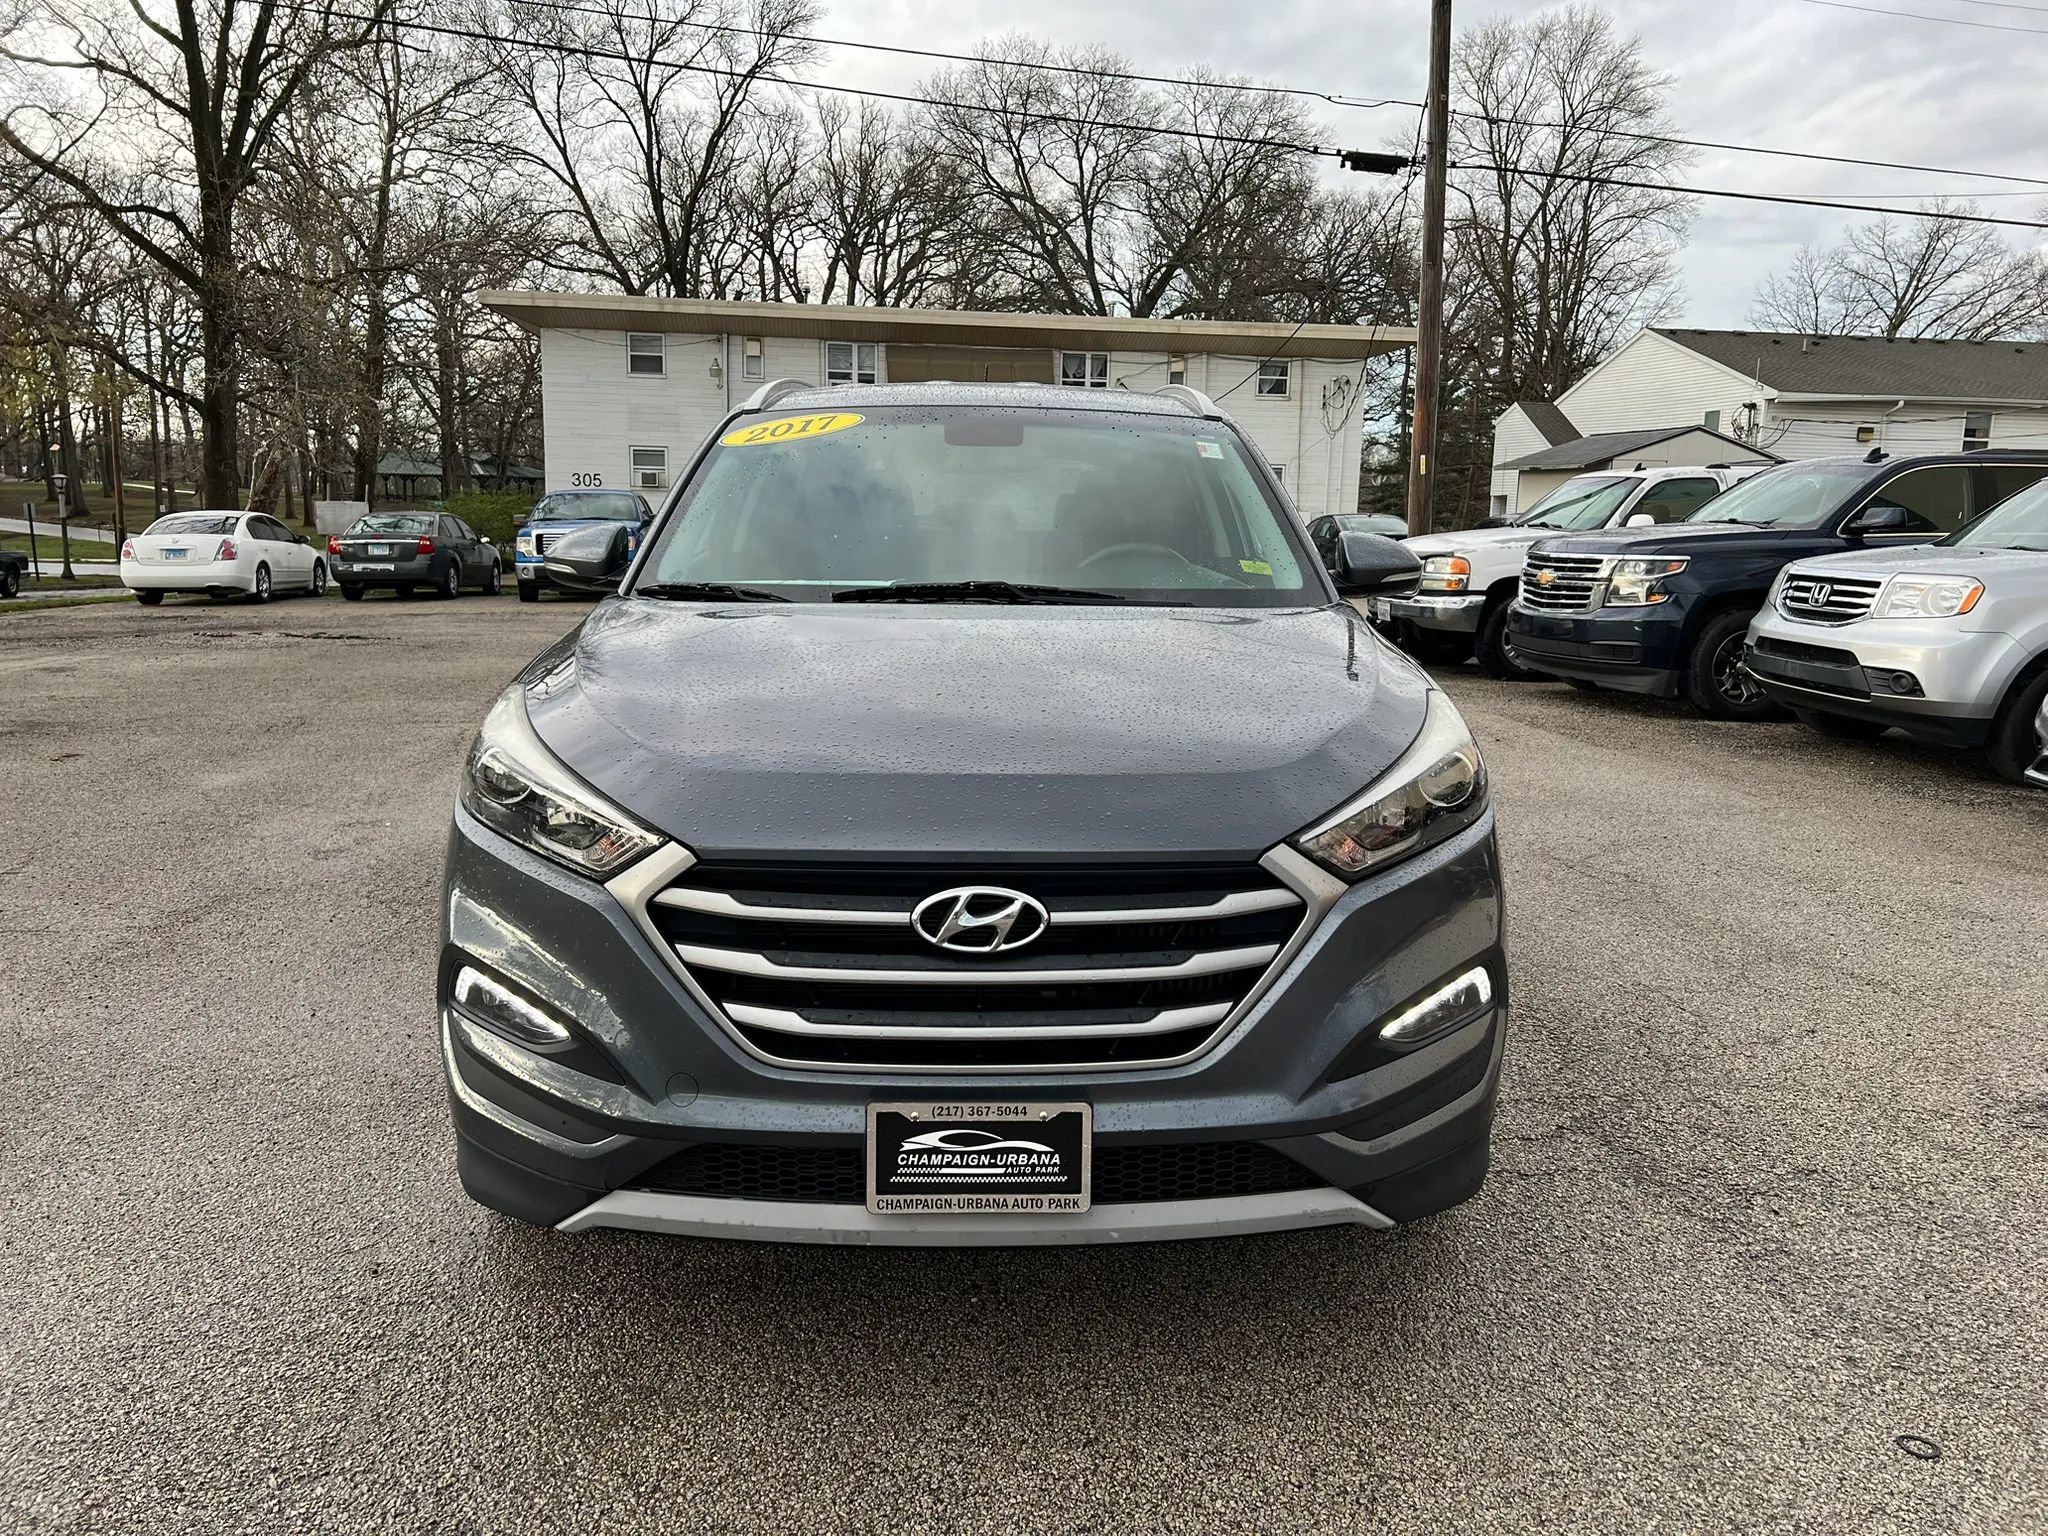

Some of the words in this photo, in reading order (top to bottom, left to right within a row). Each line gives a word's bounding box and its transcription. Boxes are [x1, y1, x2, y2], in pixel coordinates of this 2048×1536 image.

[744, 415, 838, 443] 2017
[571, 472, 602, 487] 305
[931, 1106, 964, 1118] (217)
[968, 1106, 1028, 1117] 367-5044
[897, 1153, 1061, 1166] CHAMPAIGN-URBANA
[876, 1198, 1010, 1210] CHAMPAIGN-URBANA
[1011, 1198, 1044, 1210] AUTO
[1048, 1198, 1081, 1210] PARK
